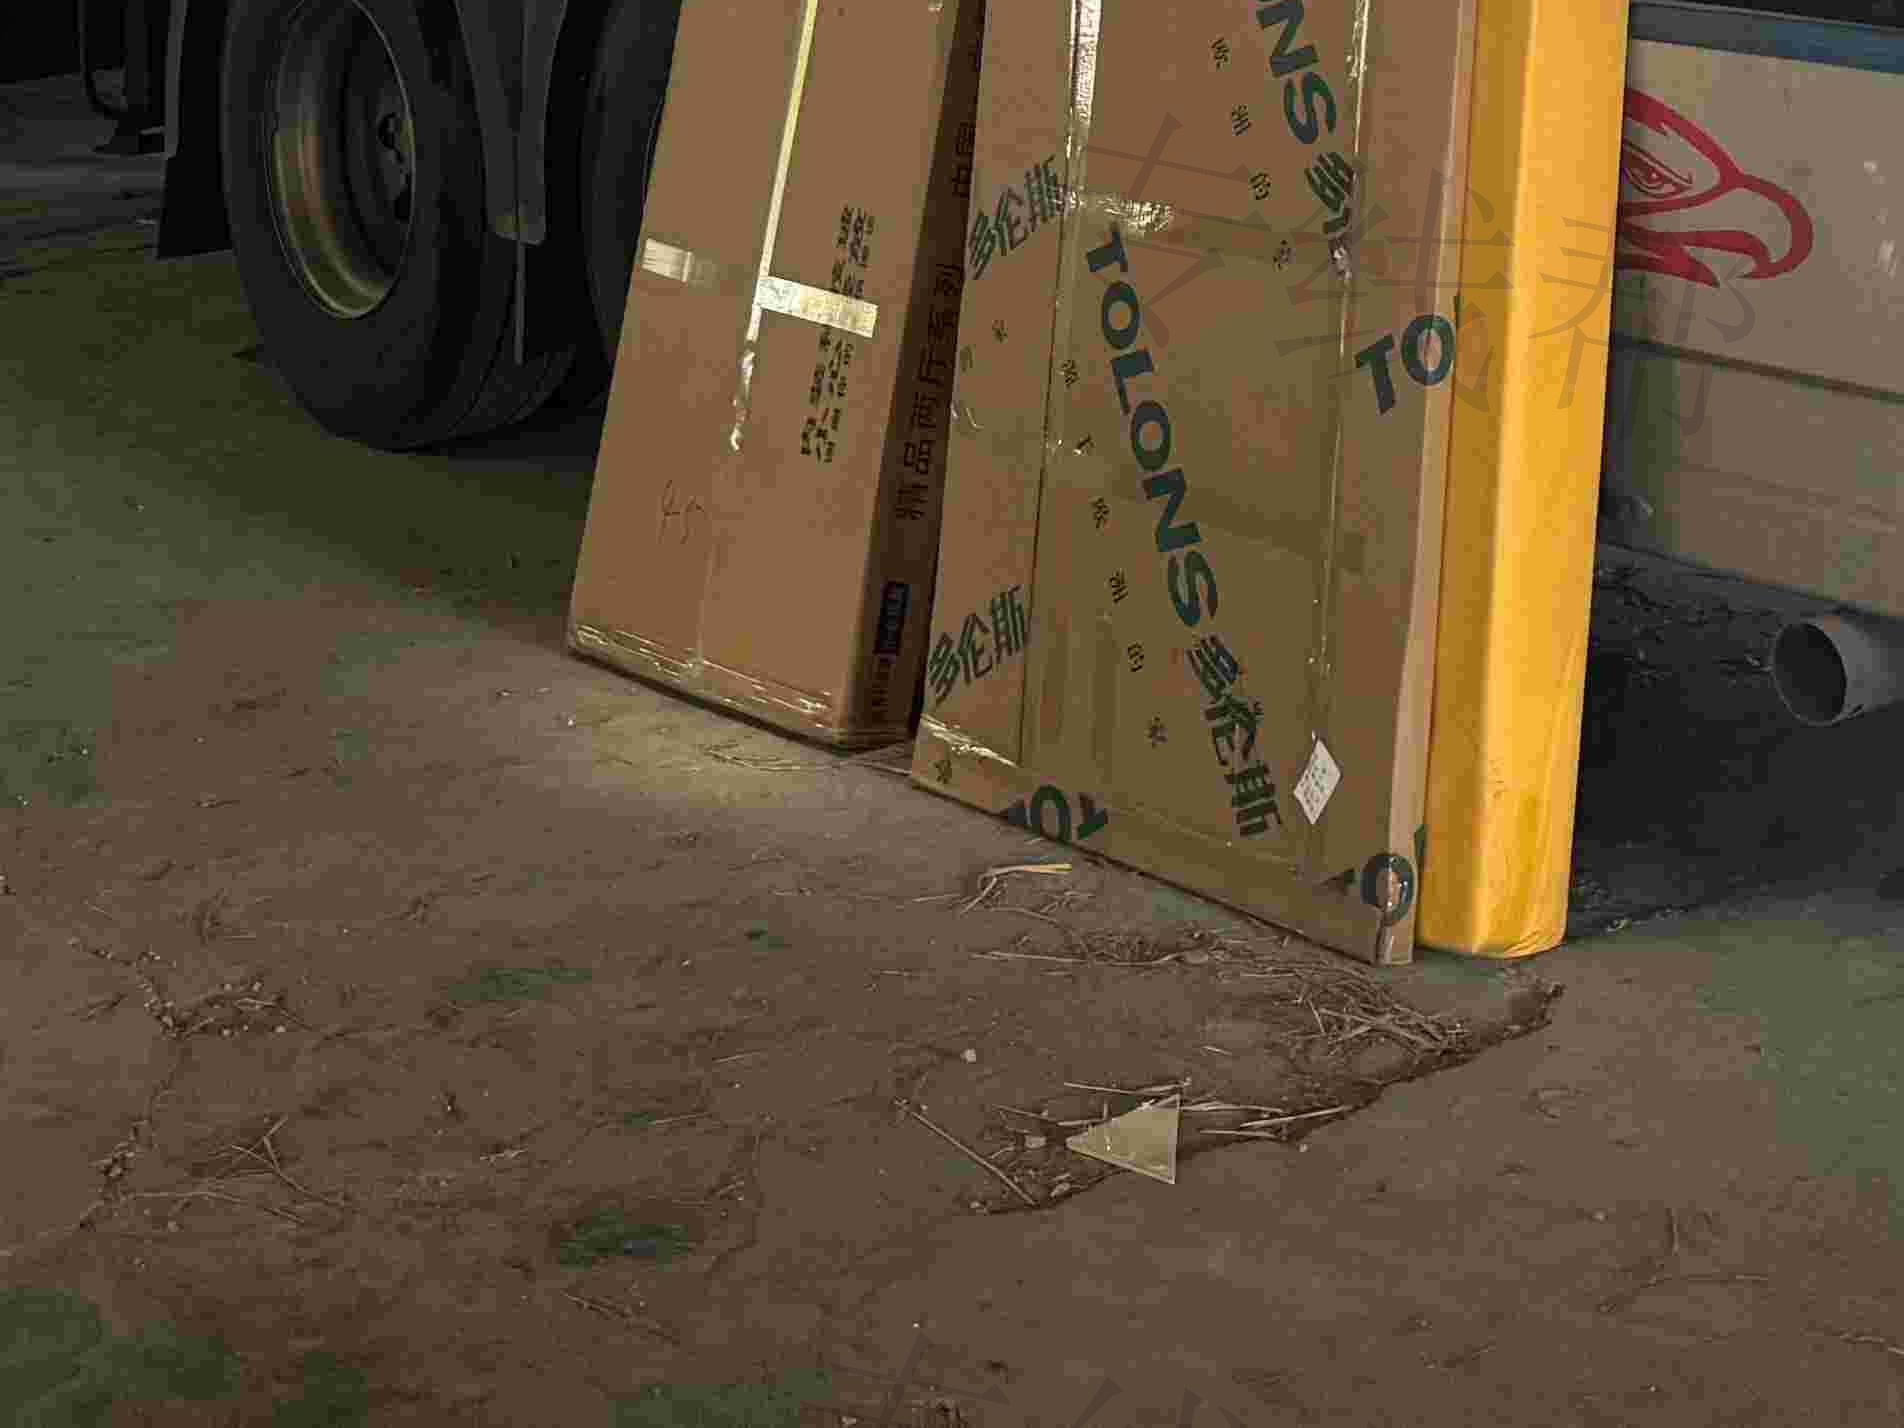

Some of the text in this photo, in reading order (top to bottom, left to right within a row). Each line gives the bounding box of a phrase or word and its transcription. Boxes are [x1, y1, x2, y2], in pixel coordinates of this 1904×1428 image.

[1085, 229, 1218, 628] TOLONS
[927, 585, 1033, 706] 多伦斯
